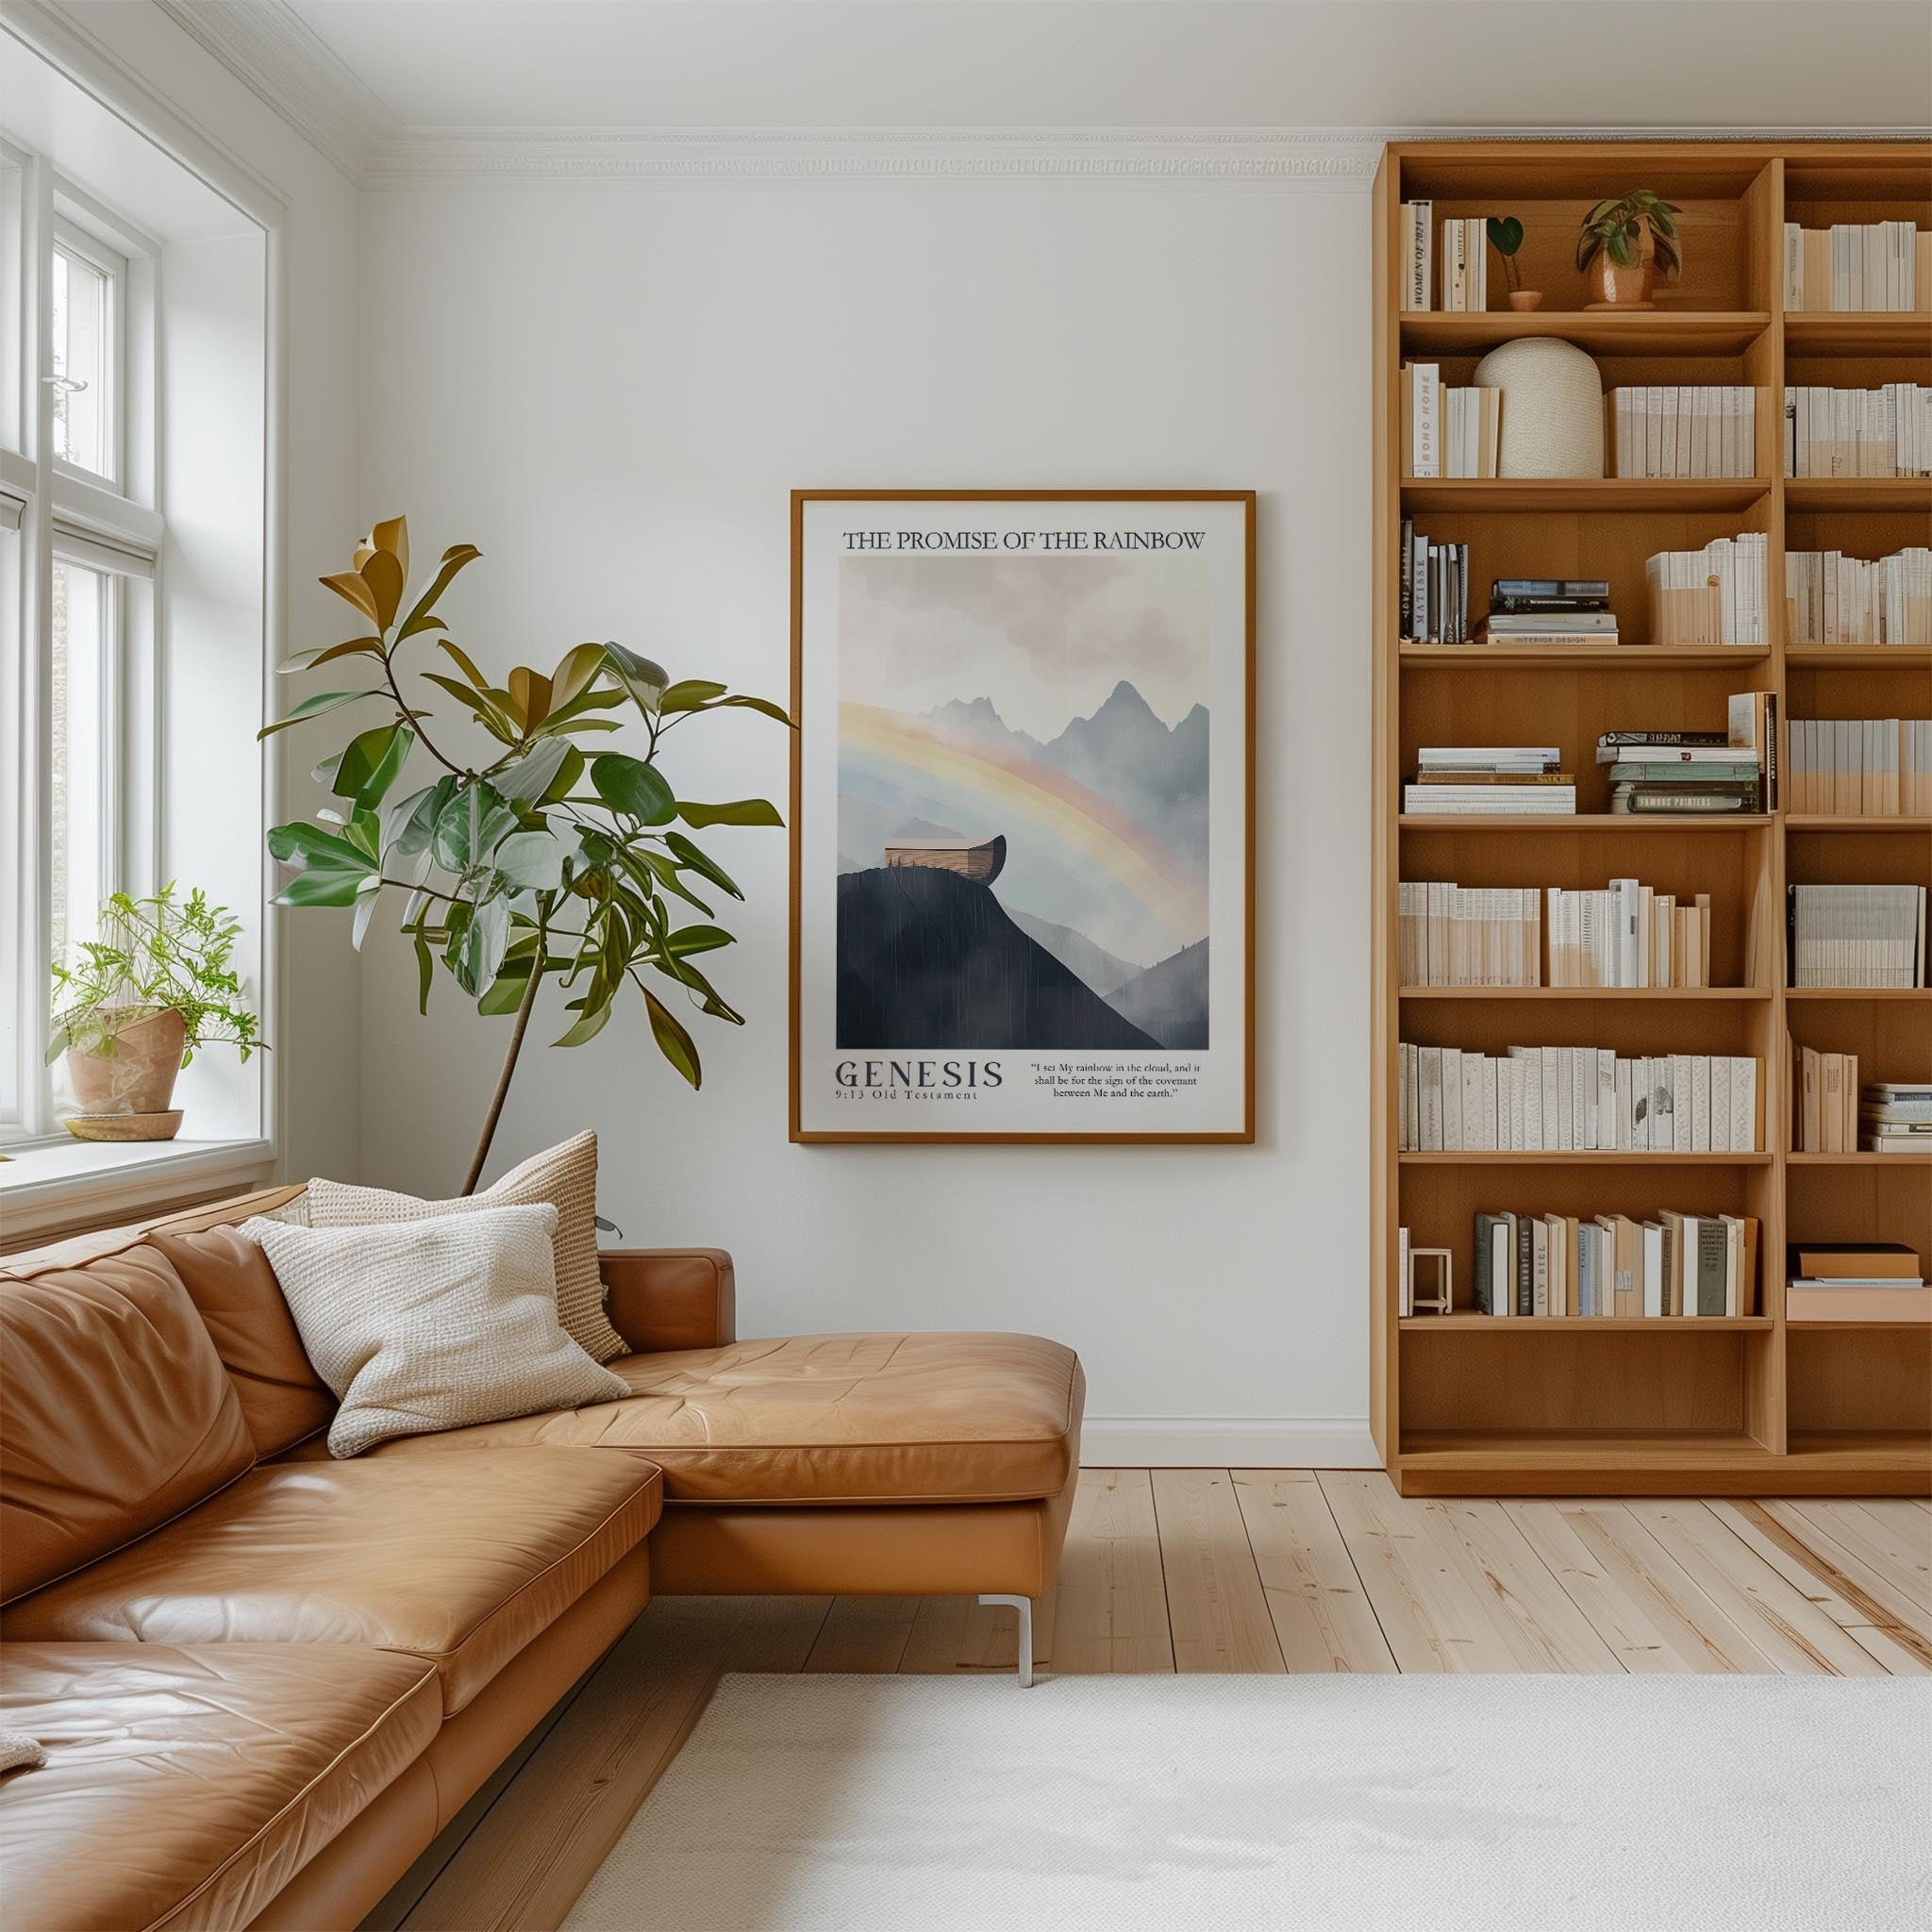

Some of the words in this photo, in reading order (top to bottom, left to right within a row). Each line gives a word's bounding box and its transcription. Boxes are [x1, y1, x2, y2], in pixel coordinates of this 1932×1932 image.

[1414, 244, 1424, 260] OF
[1414, 262, 1424, 305] WOMEN
[1422, 375, 1431, 415] HOME
[1422, 422, 1431, 461] BOHO
[842, 531, 891, 550] THE
[897, 531, 998, 550] PROMISE
[1004, 531, 1036, 550] OF
[1039, 531, 1089, 550] THE
[1093, 531, 1207, 550] RAINBOW
[1416, 558, 1425, 624] MATISSE
[1640, 797, 1672, 807] FAMOUS
[1674, 797, 1711, 807] PAINTERS
[835, 1061, 1003, 1088] GENESIS
[1059, 1063, 1074, 1074] My
[1076, 1063, 1113, 1073] rainbow
[1116, 1063, 1124, 1072] in
[1126, 1063, 1142, 1073] the
[1144, 1063, 1173, 1074] cloud,
[1174, 1063, 1191, 1073] and
[1193, 1063, 1201, 1073] it
[1034, 1075, 1055, 1085] shall
[1058, 1075, 1069, 1085] be
[1072, 1075, 1086, 1085] for
[1088, 1075, 1103, 1085] the
[1105, 1075, 1124, 1087] sign
[1125, 1075, 1138, 1085] of
[1139, 1075, 1154, 1085] the
[1156, 1077, 1197, 1086] covenant
[836, 1090, 864, 1100] 9:13
[872, 1089, 897, 1100] Old
[904, 1090, 978, 1100] Testament
[1053, 1088, 1091, 1097] between
[1093, 1088, 1108, 1097] Me
[1110, 1088, 1127, 1097] and
[1129, 1088, 1145, 1097] the
[1522, 1231, 1530, 1253] CATS
[1537, 1245, 1545, 1275] BIEL
[1522, 1291, 1530, 1307] ALL
